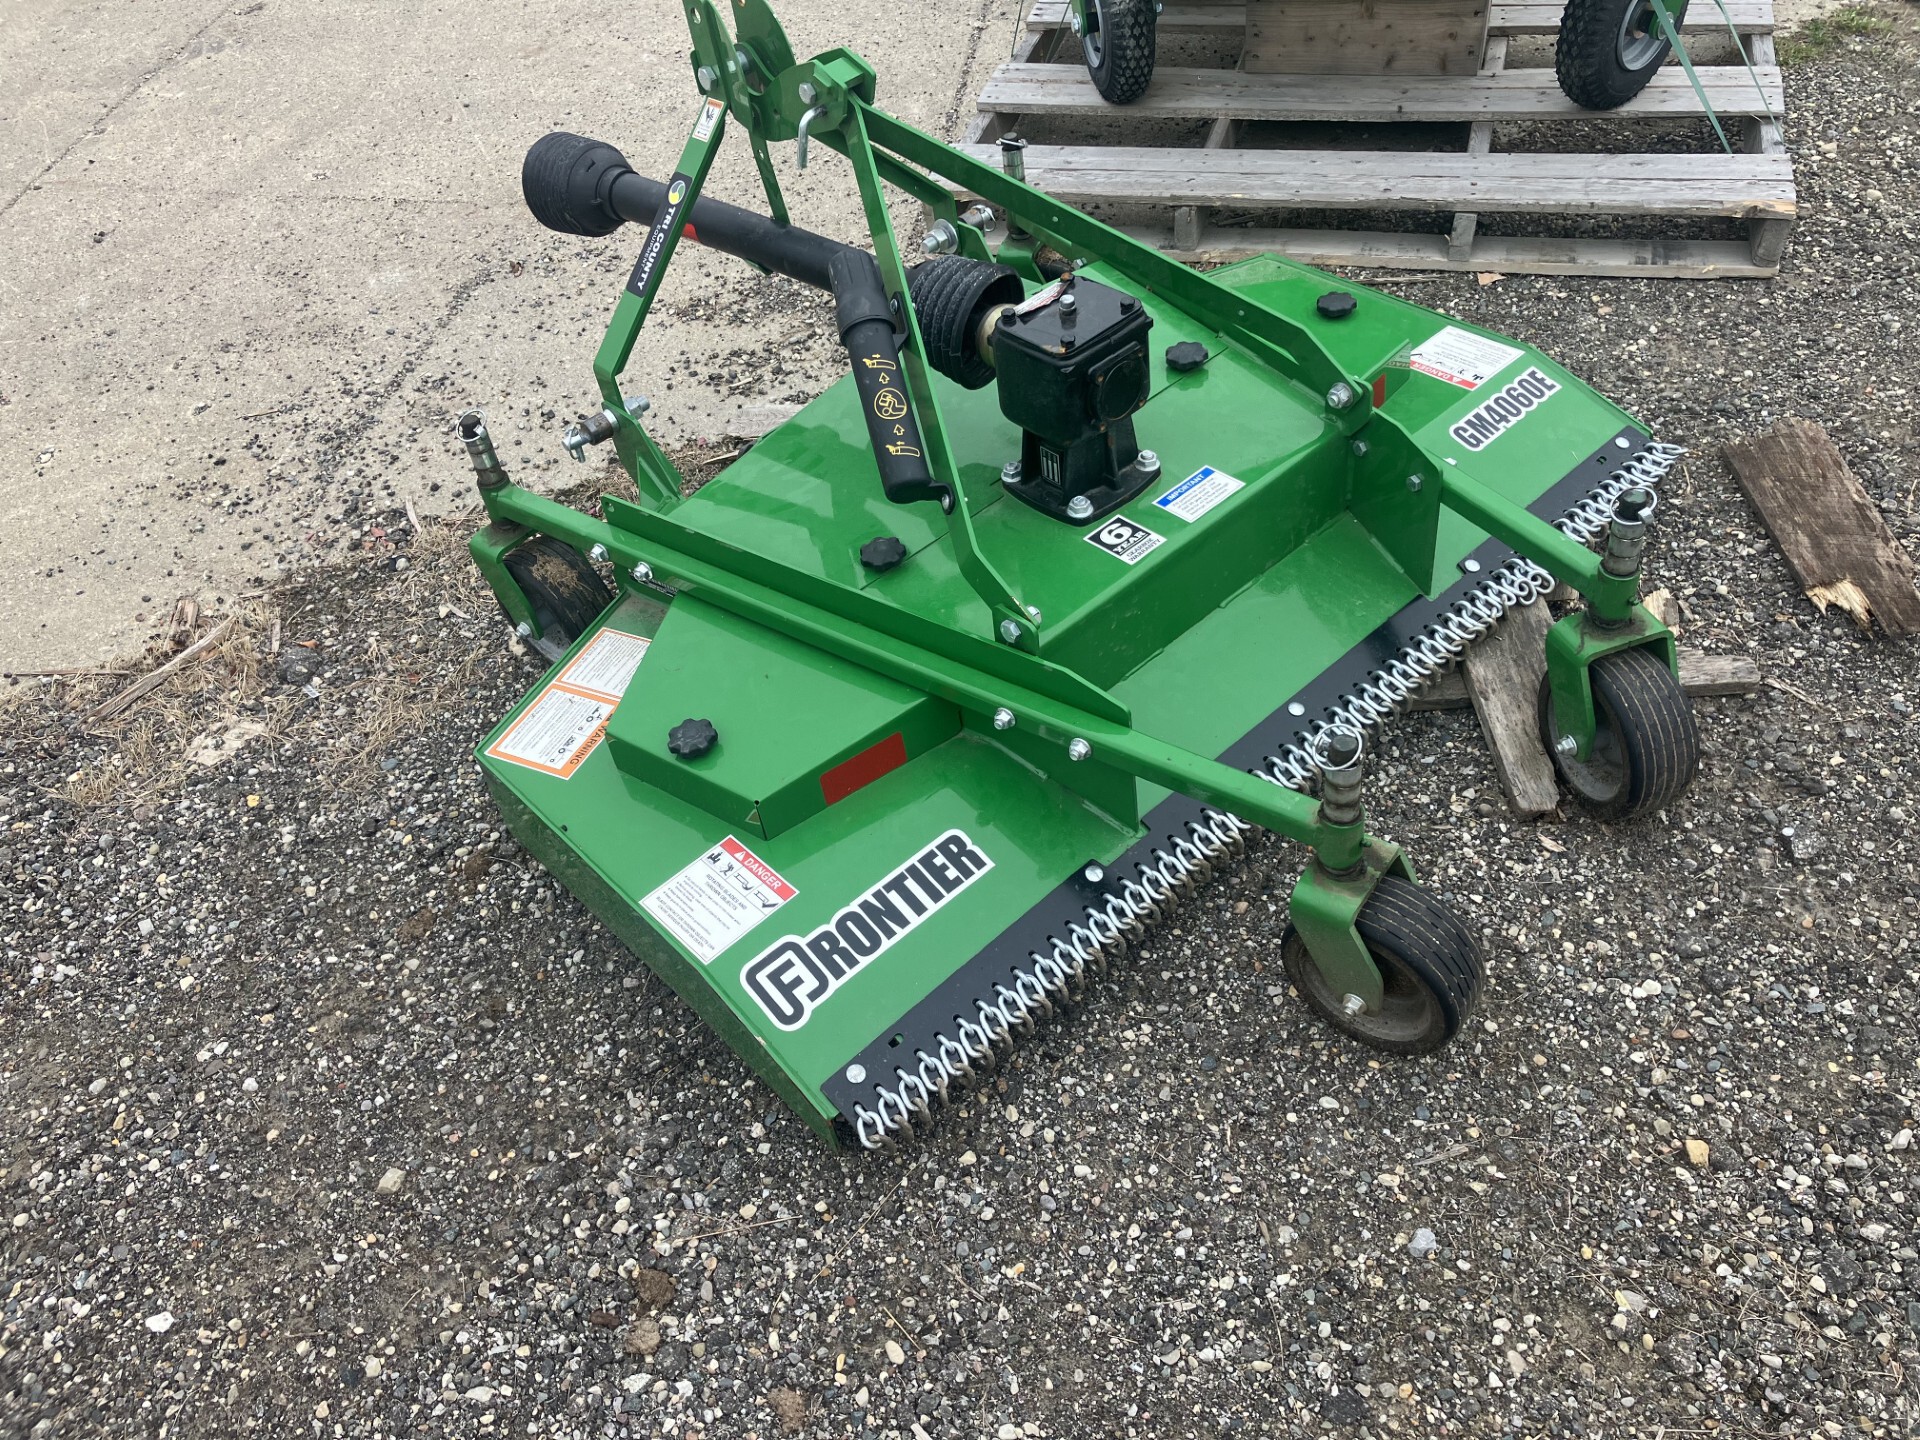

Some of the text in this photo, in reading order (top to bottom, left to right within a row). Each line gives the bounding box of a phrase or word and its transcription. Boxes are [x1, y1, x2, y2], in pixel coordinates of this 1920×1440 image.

[637, 206, 676, 290] TRI COUNTY
[641, 224, 661, 268] EQUIPMENT
[1412, 362, 1451, 380] DANGER
[1453, 370, 1557, 449] GM4060E
[1166, 473, 1205, 501] IMPORTANT
[1100, 522, 1132, 545] 6
[1113, 531, 1147, 554] YEAR
[569, 725, 607, 765] WARNING
[744, 858, 782, 890] DANGER
[746, 834, 987, 1026] FRONTIER
